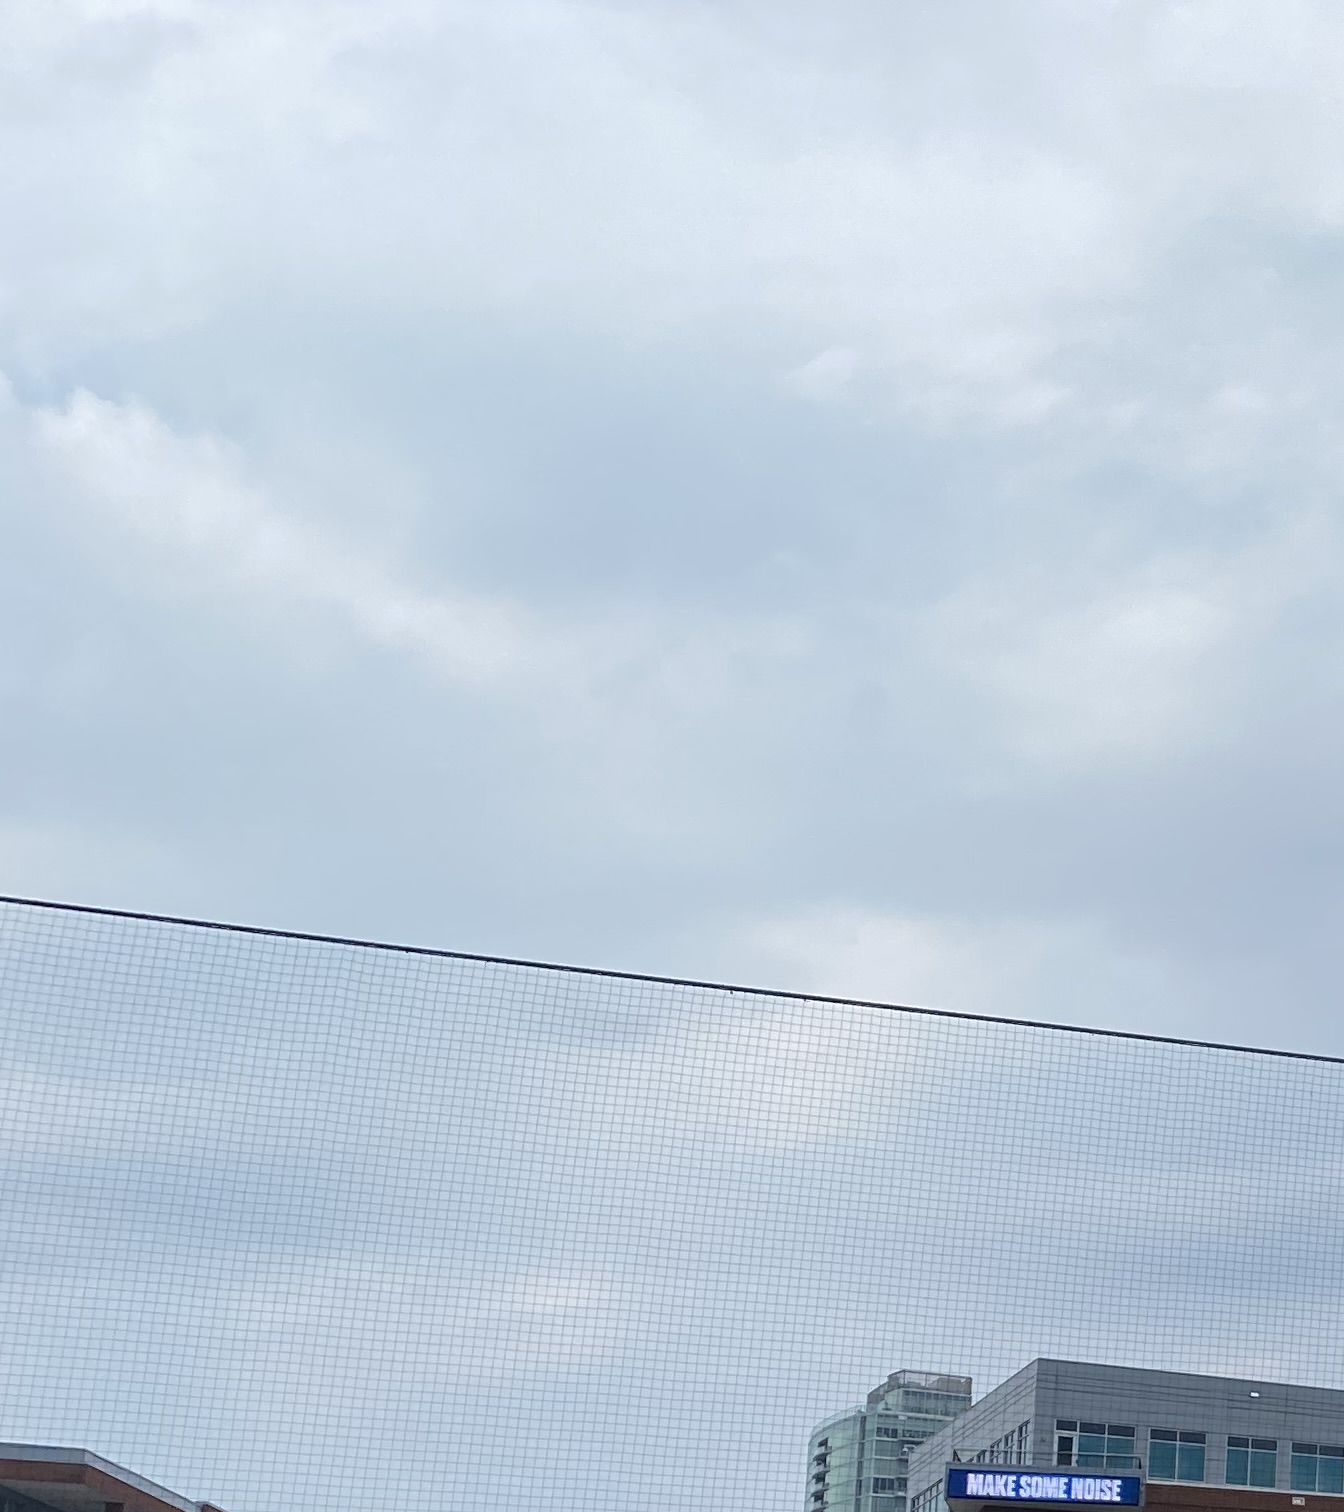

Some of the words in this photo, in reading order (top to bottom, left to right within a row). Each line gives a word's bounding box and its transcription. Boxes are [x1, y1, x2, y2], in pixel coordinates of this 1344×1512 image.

[966, 1473, 1016, 1498] MAKE
[1019, 1476, 1068, 1498] SOME
[1072, 1478, 1121, 1501] NOISE
